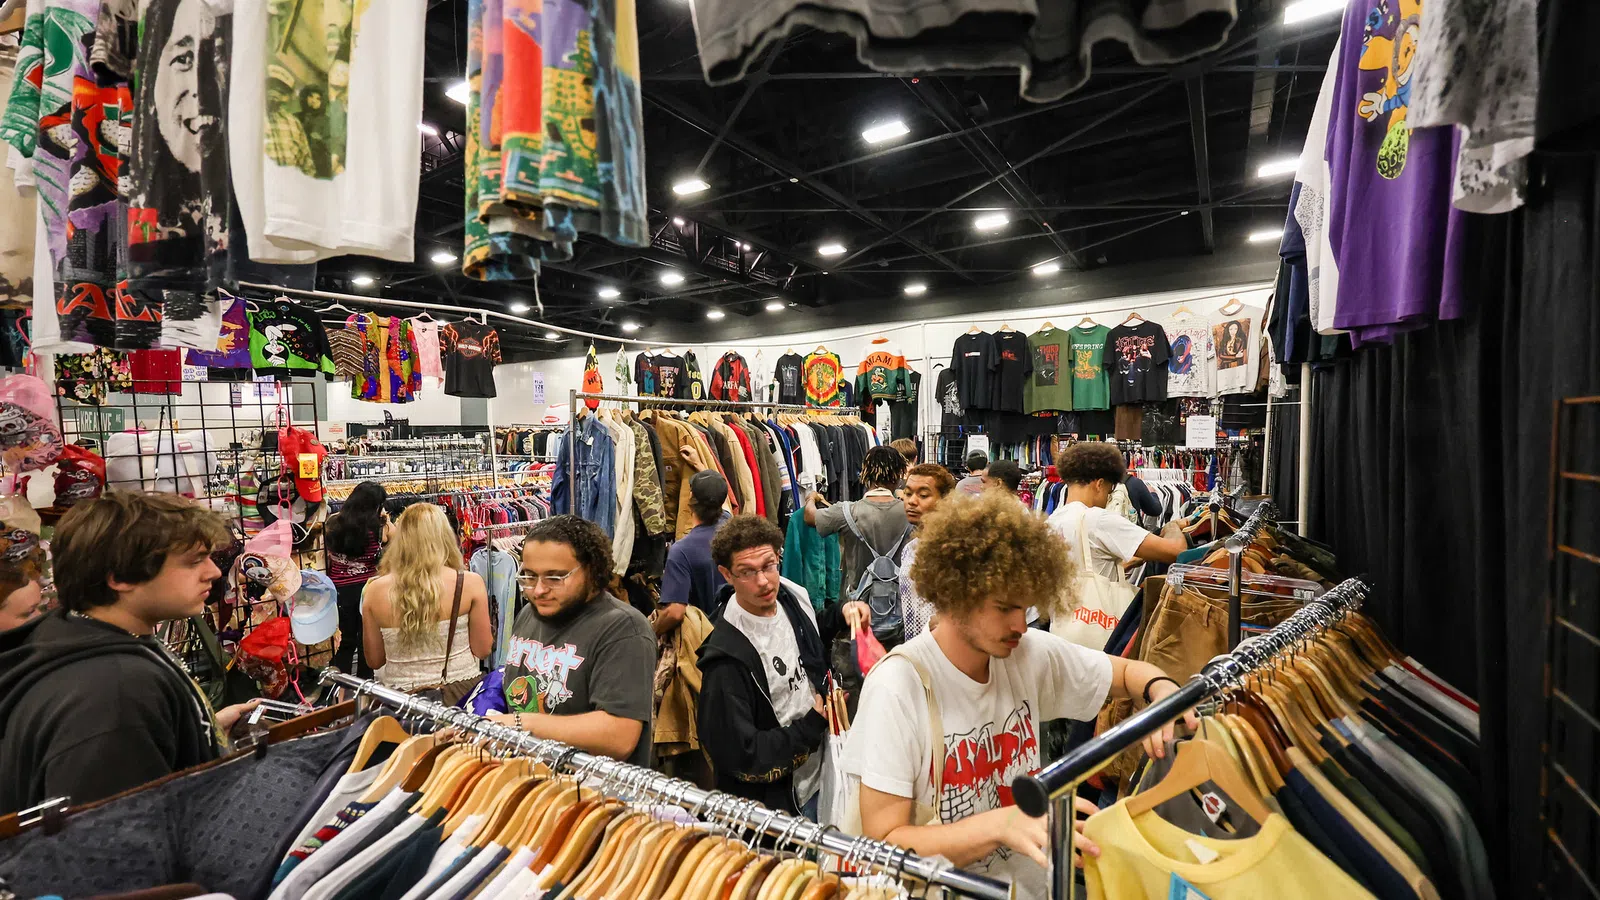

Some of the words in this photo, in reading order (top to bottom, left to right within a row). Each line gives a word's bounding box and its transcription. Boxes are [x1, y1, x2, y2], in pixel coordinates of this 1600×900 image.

[1039, 344, 1059, 355] THIRD
[866, 354, 892, 368] MIAMI
[1045, 353, 1059, 362] EYE
[79, 410, 112, 432] KREAIVE
[1073, 606, 1120, 630] THRIF
